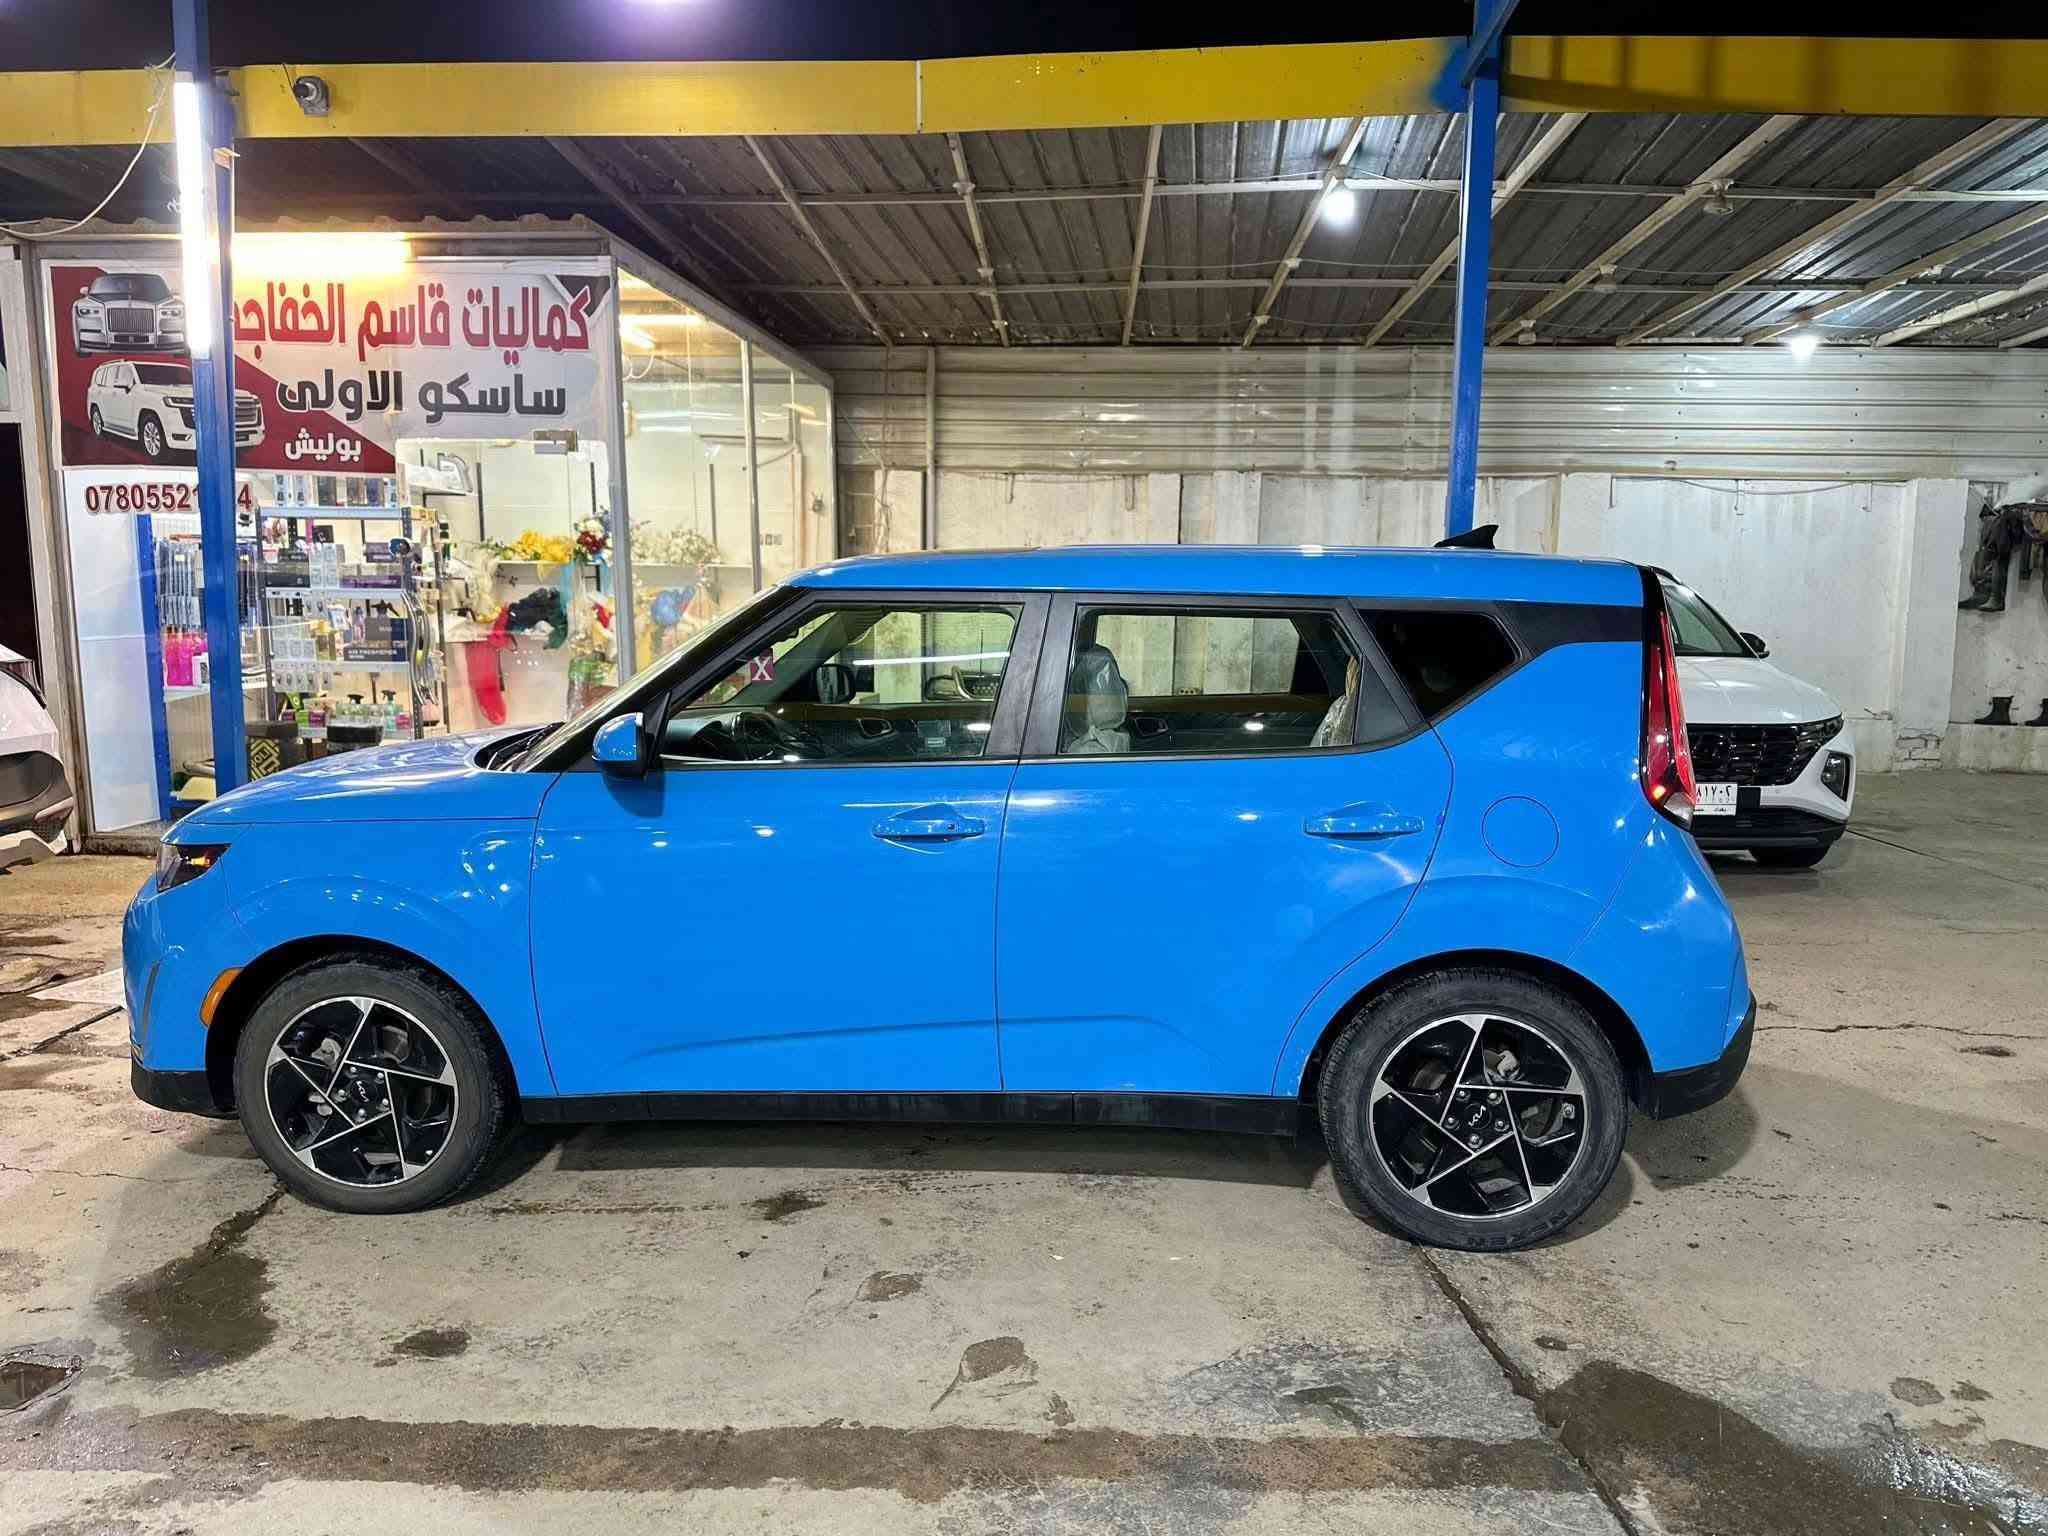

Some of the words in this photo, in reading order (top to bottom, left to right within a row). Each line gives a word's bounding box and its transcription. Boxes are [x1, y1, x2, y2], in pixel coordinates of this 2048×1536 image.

[234, 281, 346, 361] الخفاج
[358, 282, 451, 362] قاسم
[462, 285, 590, 365] كماليات
[277, 368, 403, 422] الاولى
[418, 372, 566, 424] ساسكو
[284, 427, 362, 462] بوليش
[85, 483, 252, 512] 07805524
